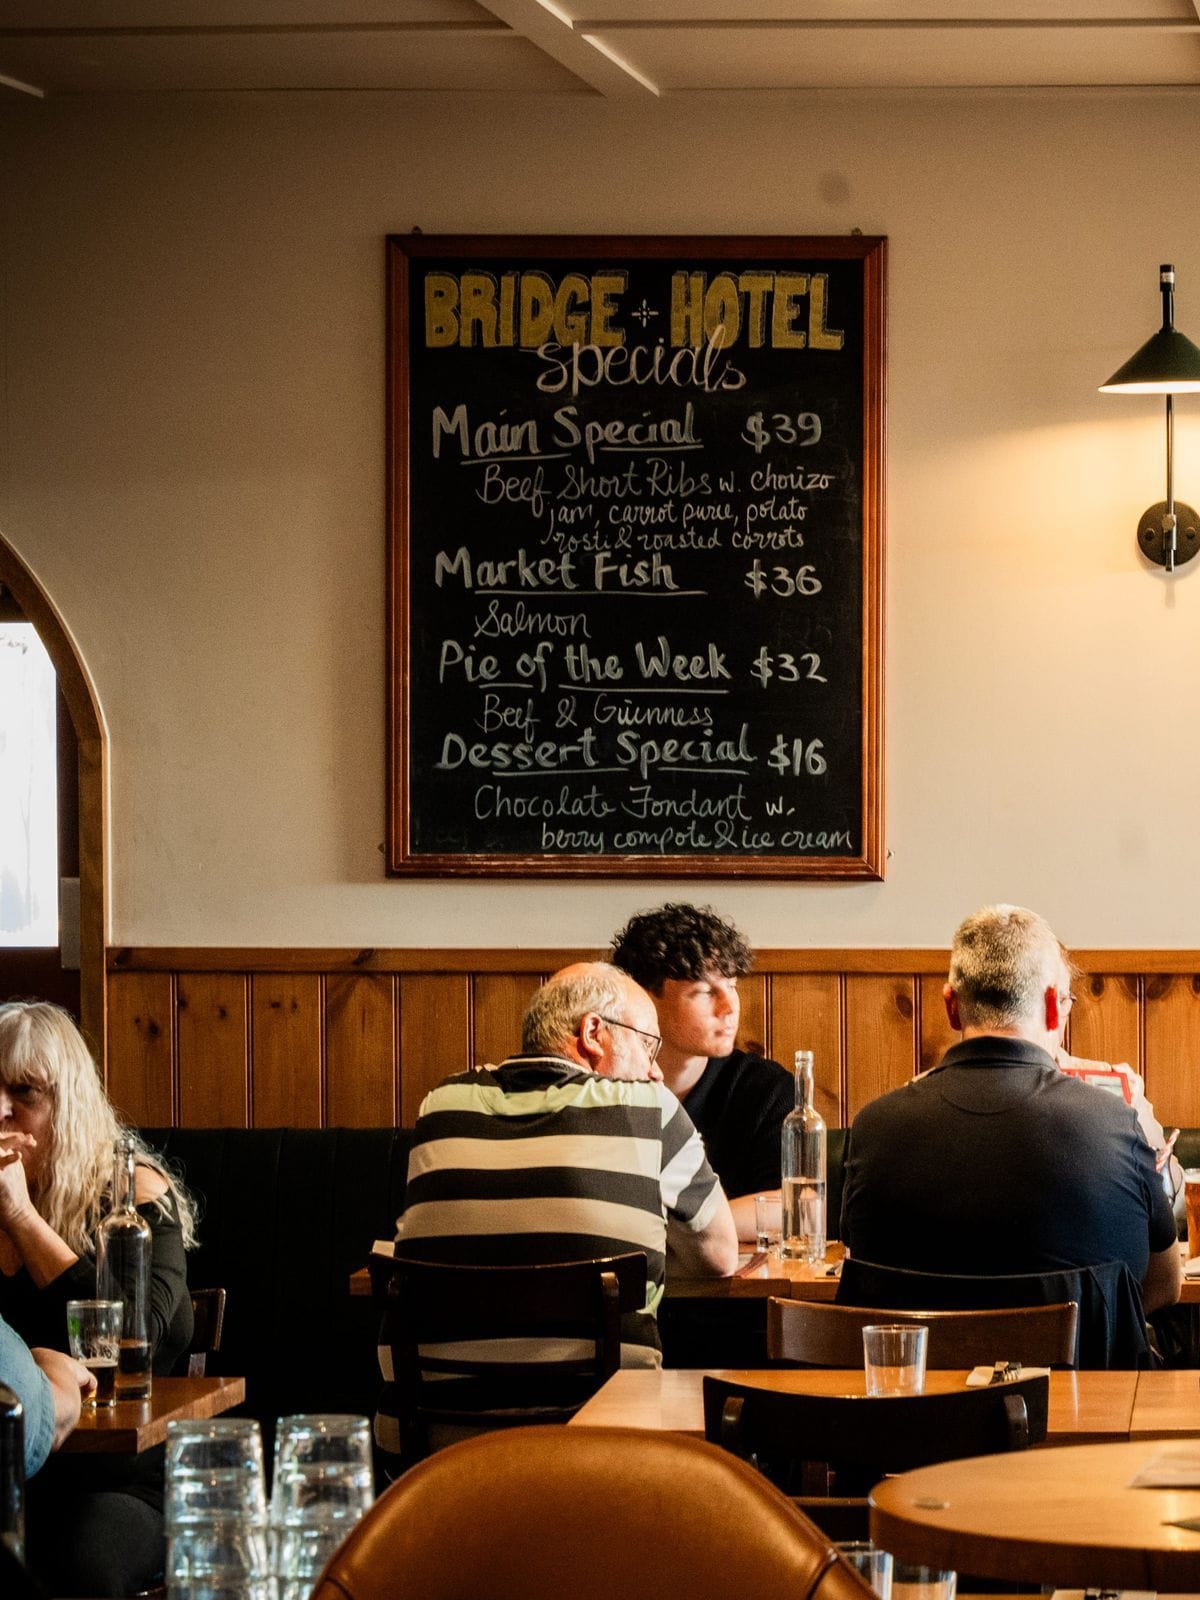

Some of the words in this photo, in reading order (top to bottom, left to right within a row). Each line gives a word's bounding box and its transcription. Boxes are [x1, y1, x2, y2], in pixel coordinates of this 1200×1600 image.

[424, 270, 629, 349] BRIDGE
[670, 270, 845, 350] HOTEL
[432, 404, 542, 459] Main
[553, 402, 703, 464] Special
[741, 411, 823, 454] $39
[475, 463, 551, 518] Beef
[556, 460, 642, 500] Short
[646, 457, 712, 497] Ribs
[719, 471, 742, 493] w.
[552, 529, 611, 553] rosti
[614, 525, 633, 549] &
[637, 525, 723, 550] roasted
[608, 499, 678, 526] carrot
[746, 495, 809, 534] potato
[435, 548, 578, 590] Market
[594, 552, 680, 590] Fish
[743, 558, 823, 598] $36
[474, 599, 592, 639] Salmon
[439, 639, 501, 684] Pie
[516, 641, 552, 692] of
[564, 643, 624, 680] the
[635, 636, 733, 680] Week
[749, 646, 828, 689] $32
[475, 694, 541, 743] Beef
[555, 695, 578, 728] &
[594, 693, 714, 727] Guinness
[434, 727, 599, 770] Dessert
[616, 723, 759, 780] Special
[767, 734, 829, 776] $16
[474, 785, 617, 820] Chocolate
[622, 784, 752, 820] Fondant
[765, 796, 795, 817] w.
[541, 822, 604, 854] berry
[614, 820, 713, 853] compote
[714, 820, 737, 848] &
[741, 829, 775, 847] ice
[781, 829, 853, 850] cream
